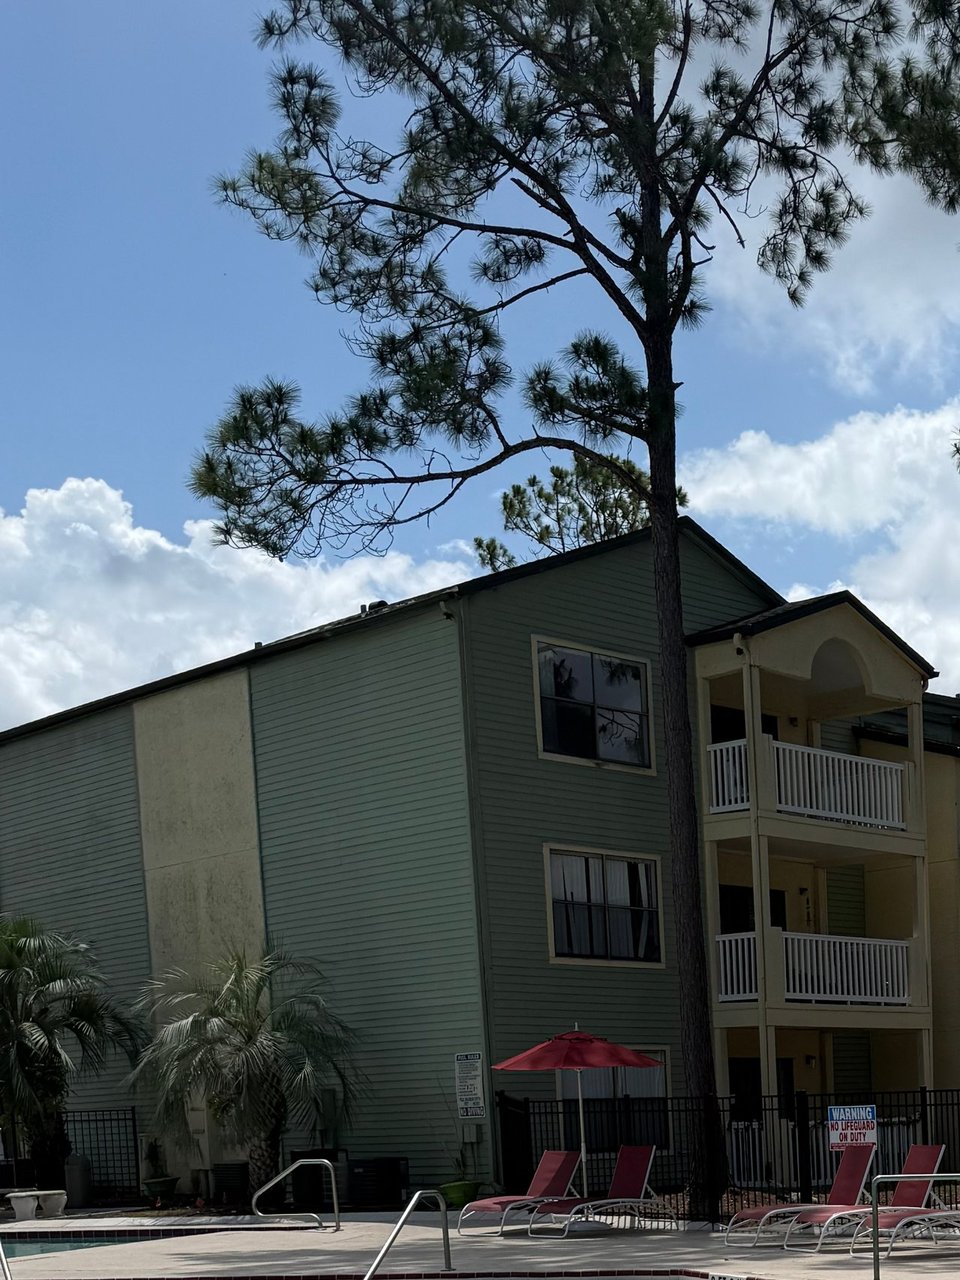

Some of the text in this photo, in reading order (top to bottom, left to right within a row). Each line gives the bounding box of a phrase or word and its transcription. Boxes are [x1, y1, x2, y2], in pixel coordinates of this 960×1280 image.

[832, 1108, 872, 1120] WARNING
[830, 1121, 875, 1131] NO LIFEGUARD
[839, 1131, 867, 1142] ON DUTY
